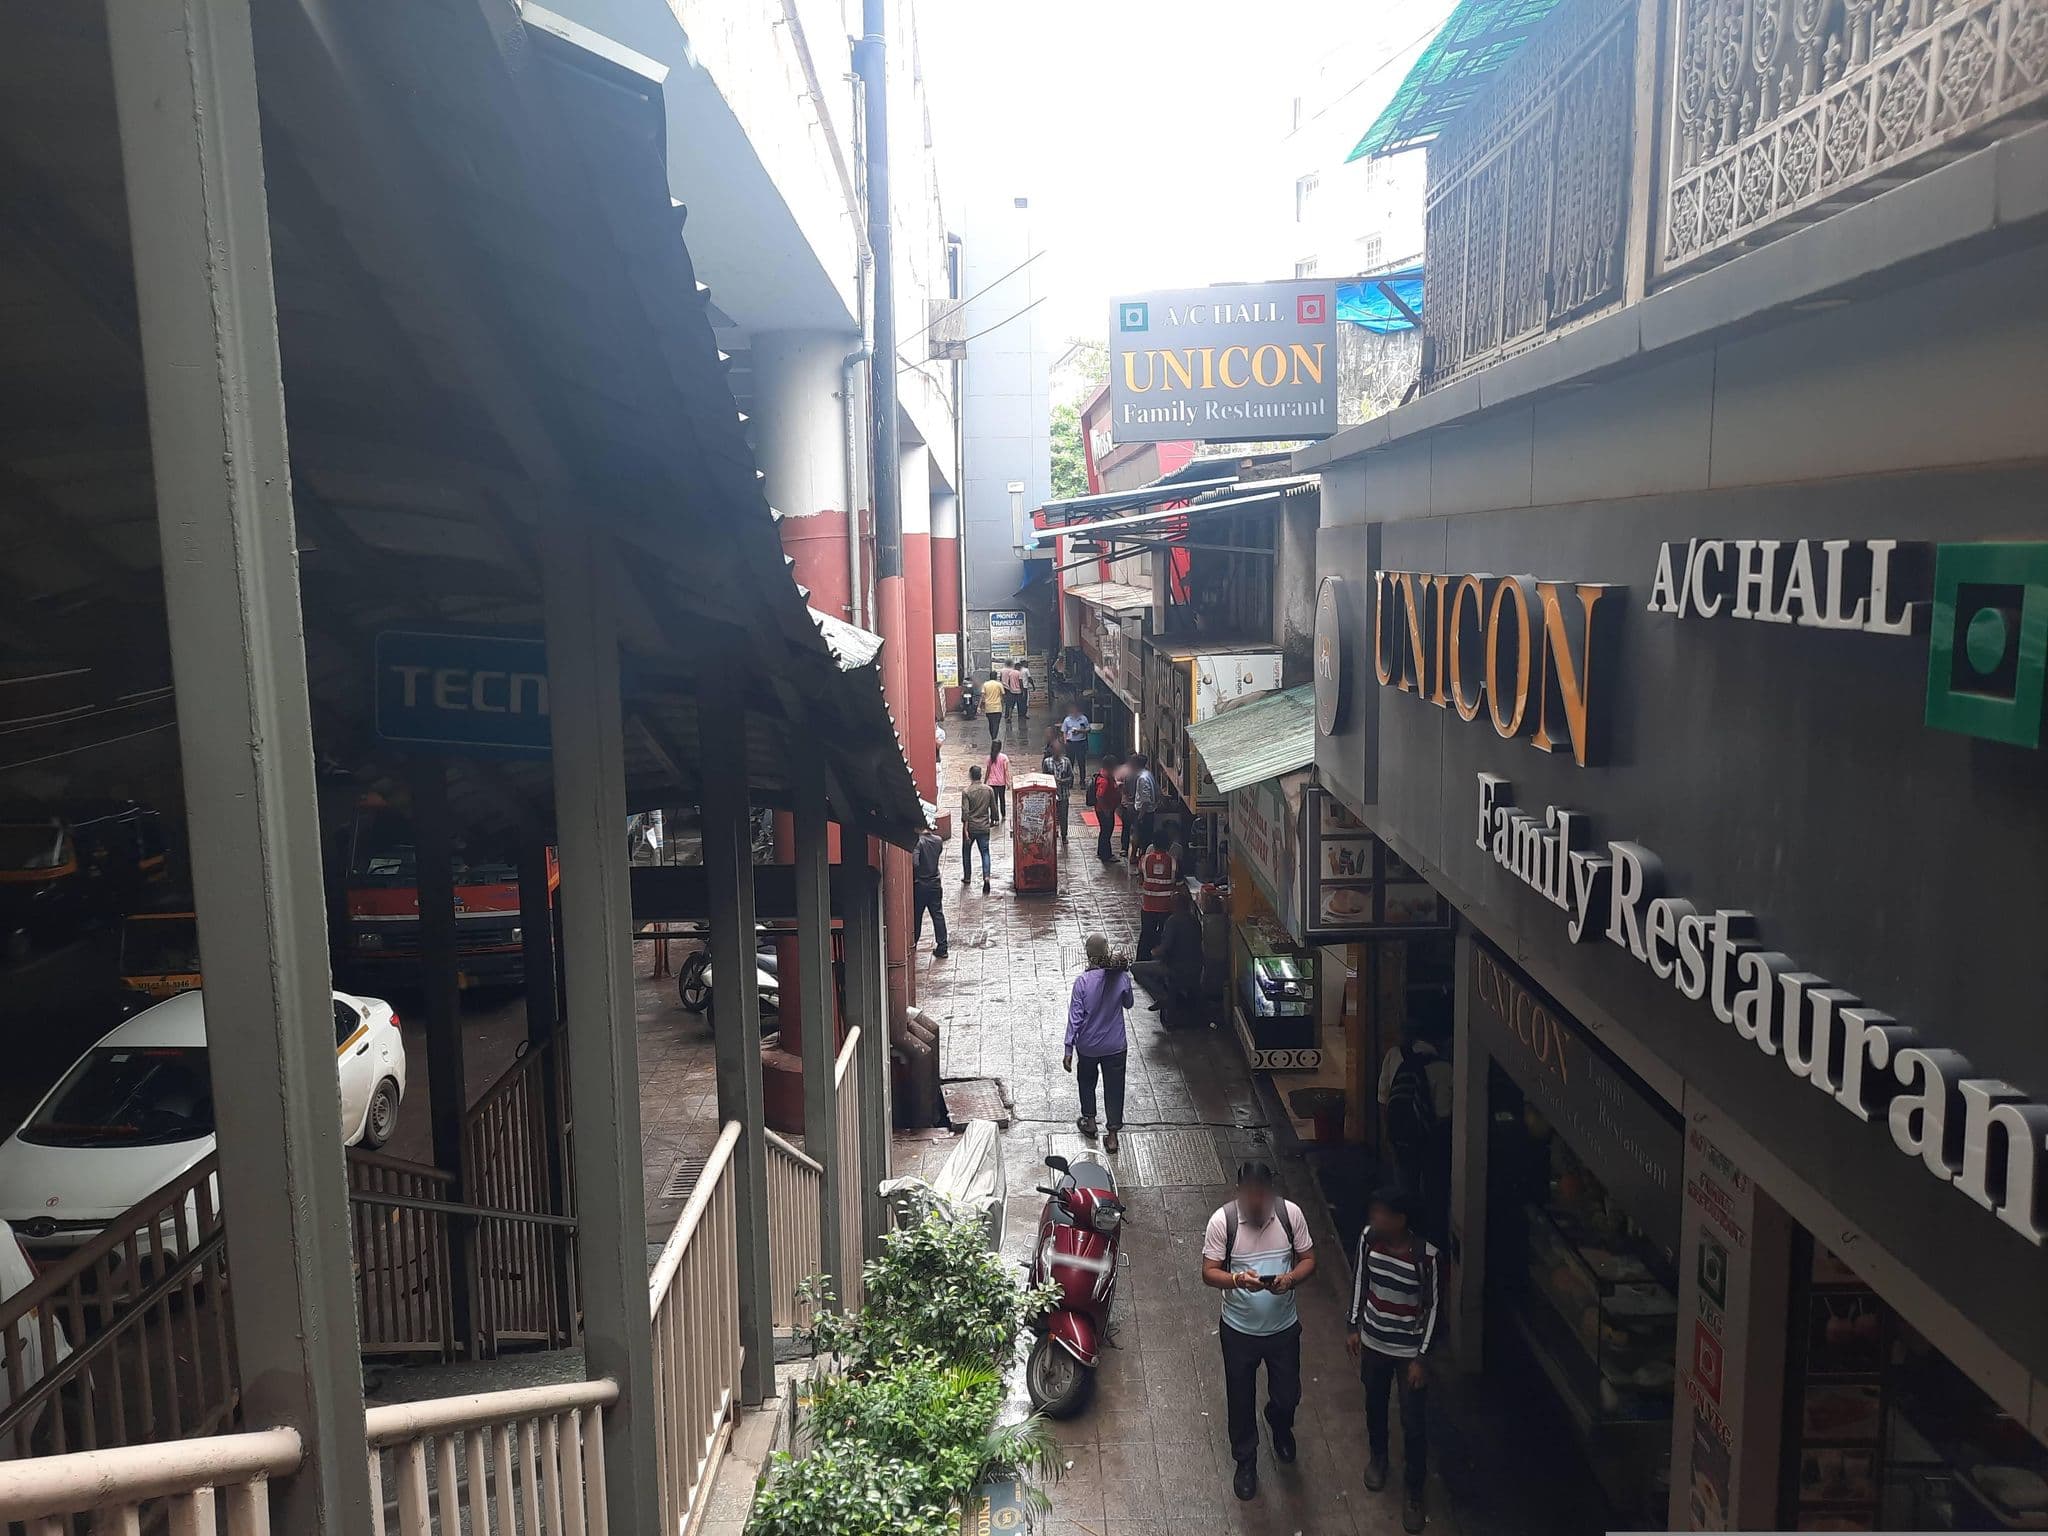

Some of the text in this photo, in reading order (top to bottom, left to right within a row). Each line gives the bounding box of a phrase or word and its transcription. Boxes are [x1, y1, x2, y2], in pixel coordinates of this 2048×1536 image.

[1163, 302, 1286, 327] A/C HALL
[1122, 343, 1326, 394] UNICON
[1123, 397, 1326, 427] Family Restaurant
[1647, 536, 1914, 636] A/C HALL
[389, 664, 549, 717] TECN
[1373, 570, 1618, 768] UNICON
[1474, 948, 1572, 1086] UNICON
[1475, 771, 2048, 1247] Family Restauran
